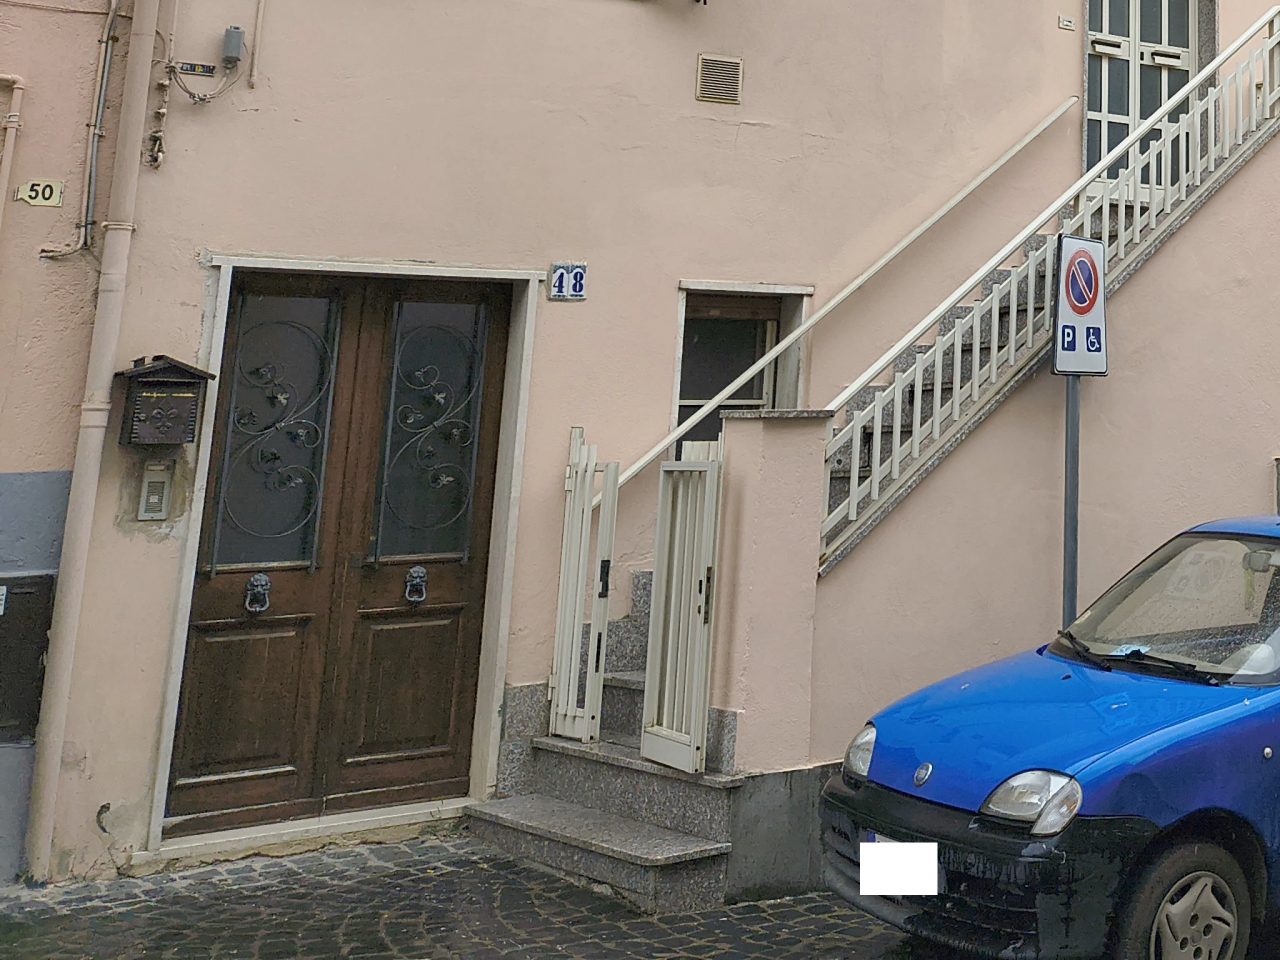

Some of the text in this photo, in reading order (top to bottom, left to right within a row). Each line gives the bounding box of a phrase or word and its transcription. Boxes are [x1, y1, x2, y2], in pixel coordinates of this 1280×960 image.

[28, 183, 54, 201] 50
[553, 271, 584, 293] 48
[1064, 328, 1073, 348] P
